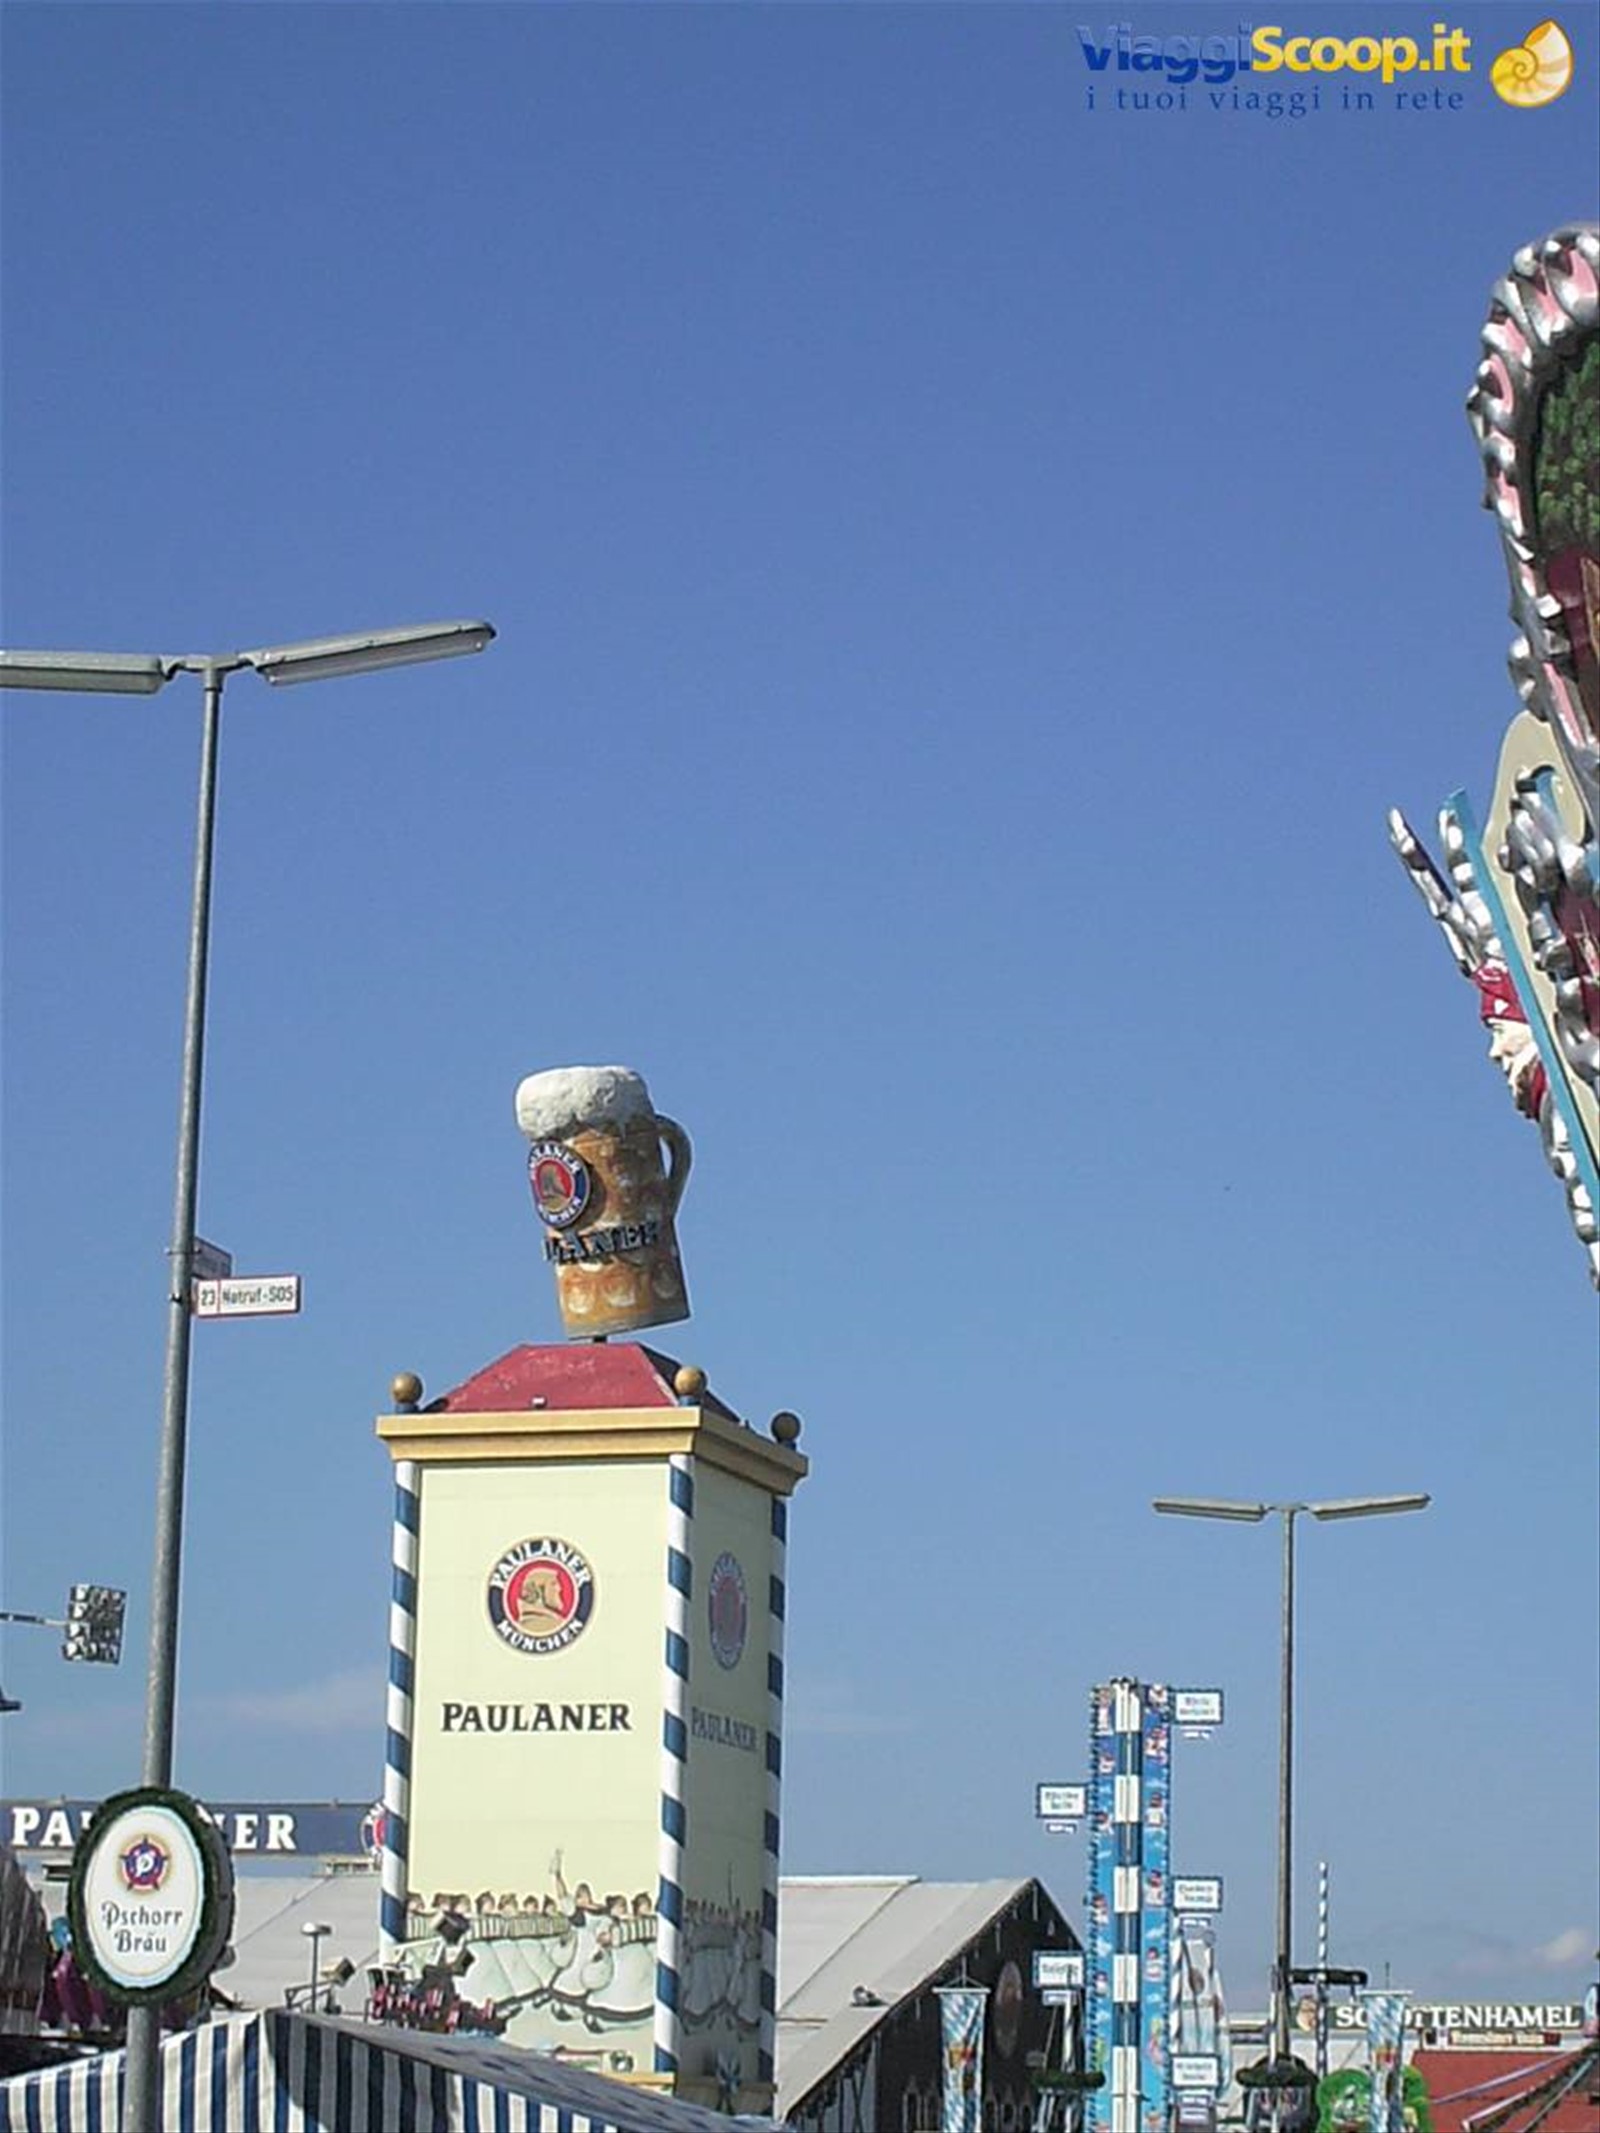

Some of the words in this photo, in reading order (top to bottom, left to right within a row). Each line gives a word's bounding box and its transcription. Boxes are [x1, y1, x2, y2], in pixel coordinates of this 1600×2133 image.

[200, 1288, 216, 1306] 23
[489, 1539, 592, 1589] PAULANER
[440, 1702, 632, 1733] PAULANER
[101, 1900, 184, 1930] Pschorr
[113, 1928, 168, 1953] Bräu
